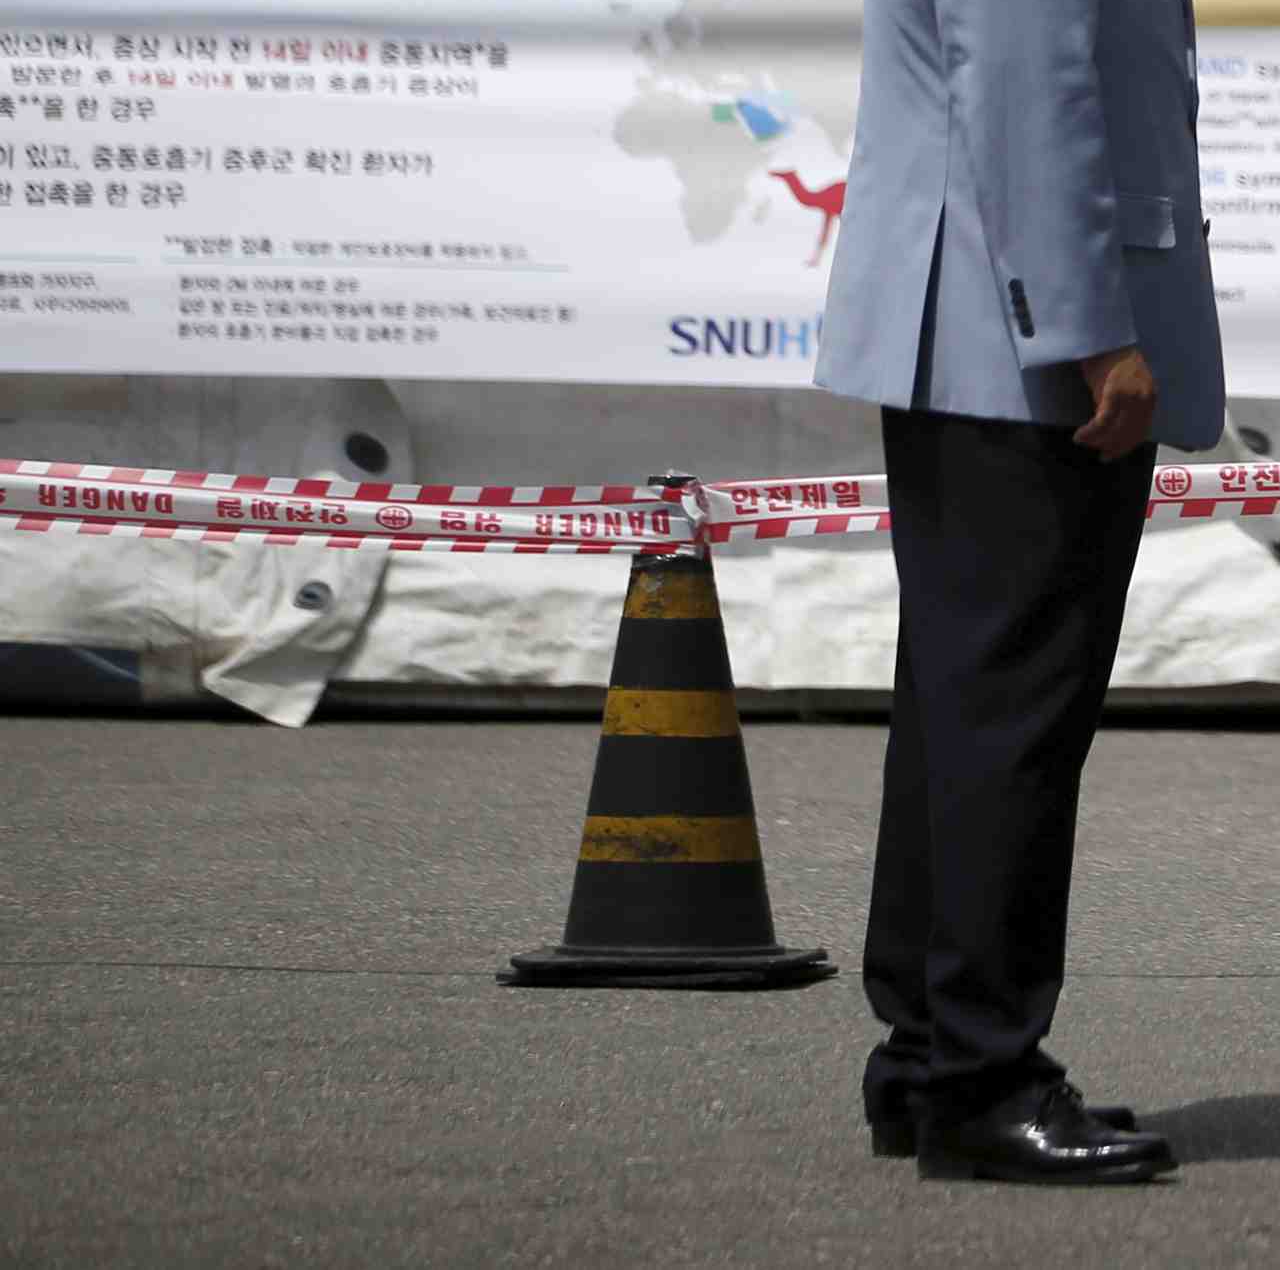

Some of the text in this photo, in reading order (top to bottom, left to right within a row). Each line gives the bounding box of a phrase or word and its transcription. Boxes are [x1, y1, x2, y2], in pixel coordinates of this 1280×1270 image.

[37, 483, 174, 516] DANGER
[216, 496, 349, 526] 안전제일
[731, 480, 862, 516] 안전제일
[533, 509, 672, 539] DANGER
